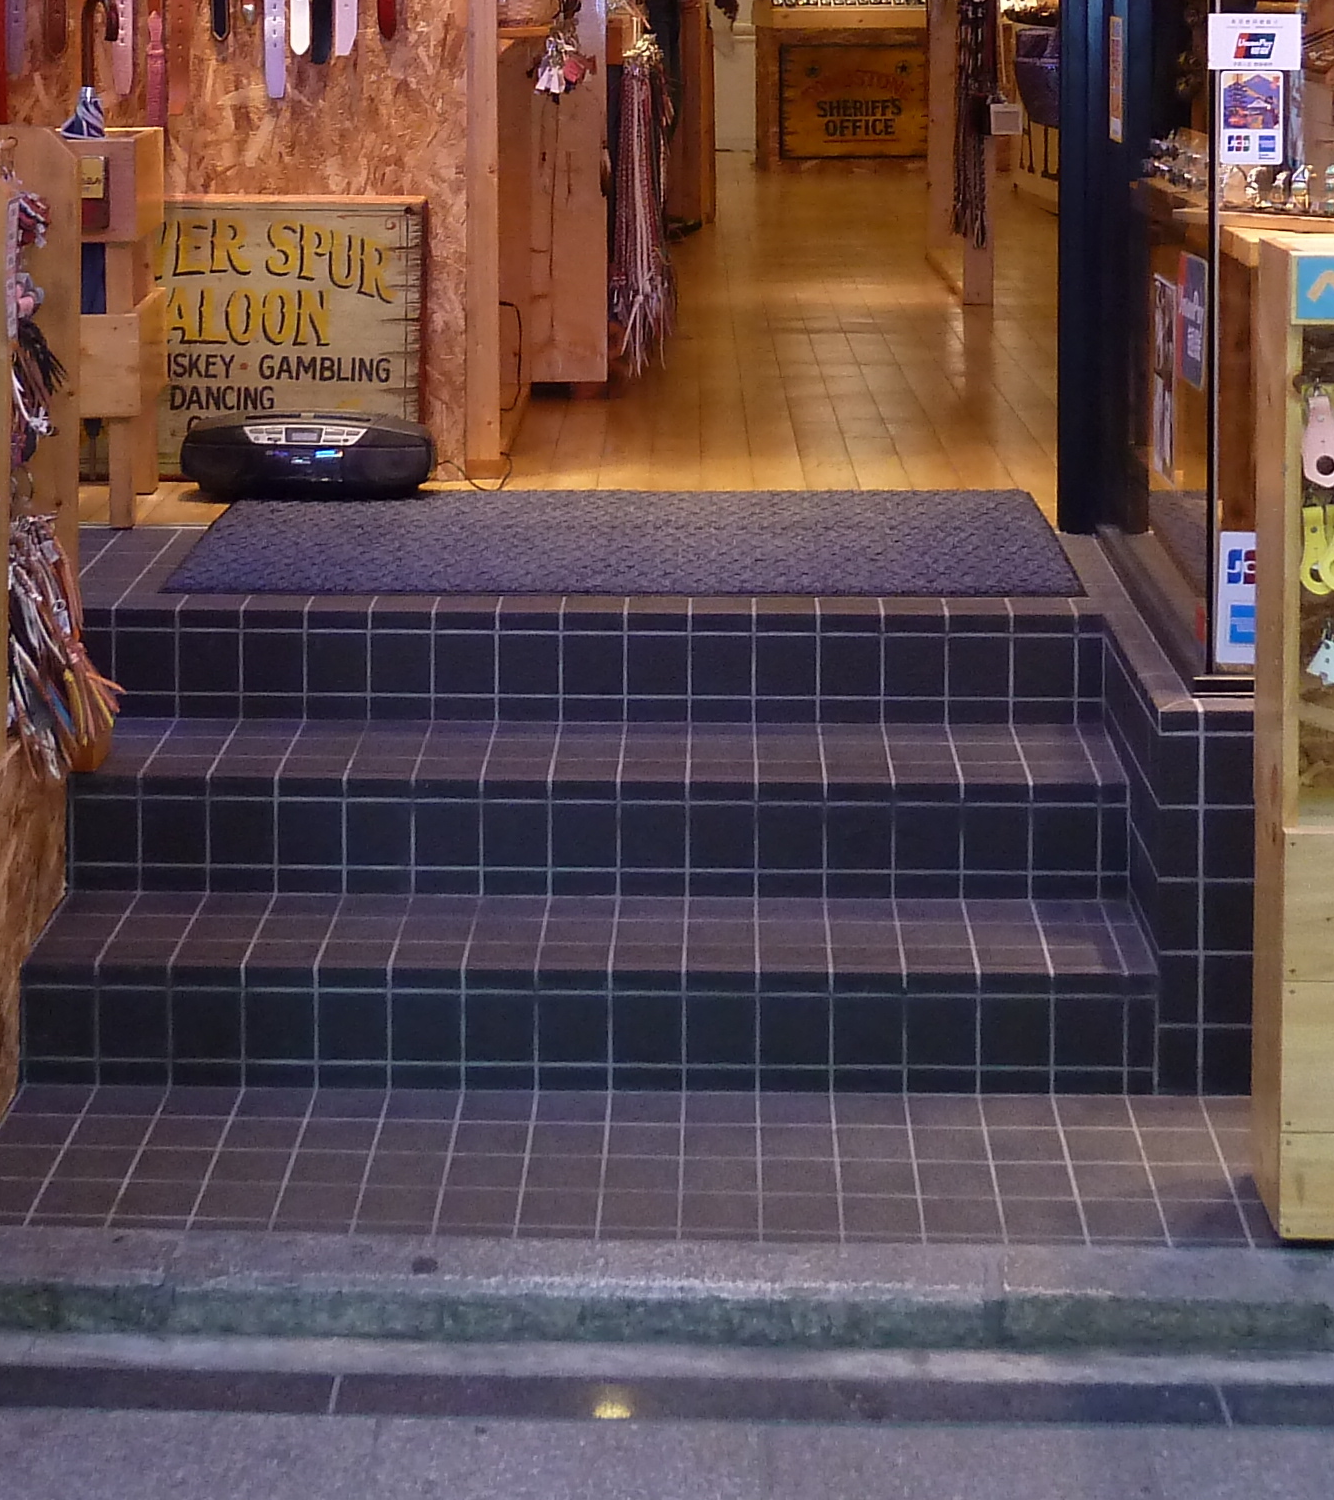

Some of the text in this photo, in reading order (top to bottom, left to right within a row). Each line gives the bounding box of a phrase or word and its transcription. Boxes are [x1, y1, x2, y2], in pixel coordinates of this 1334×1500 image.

[824, 118, 896, 137] OFFICE
[266, 219, 398, 304] SPUR
[259, 355, 391, 383] GAMBLING
[169, 384, 275, 412] DANCING
